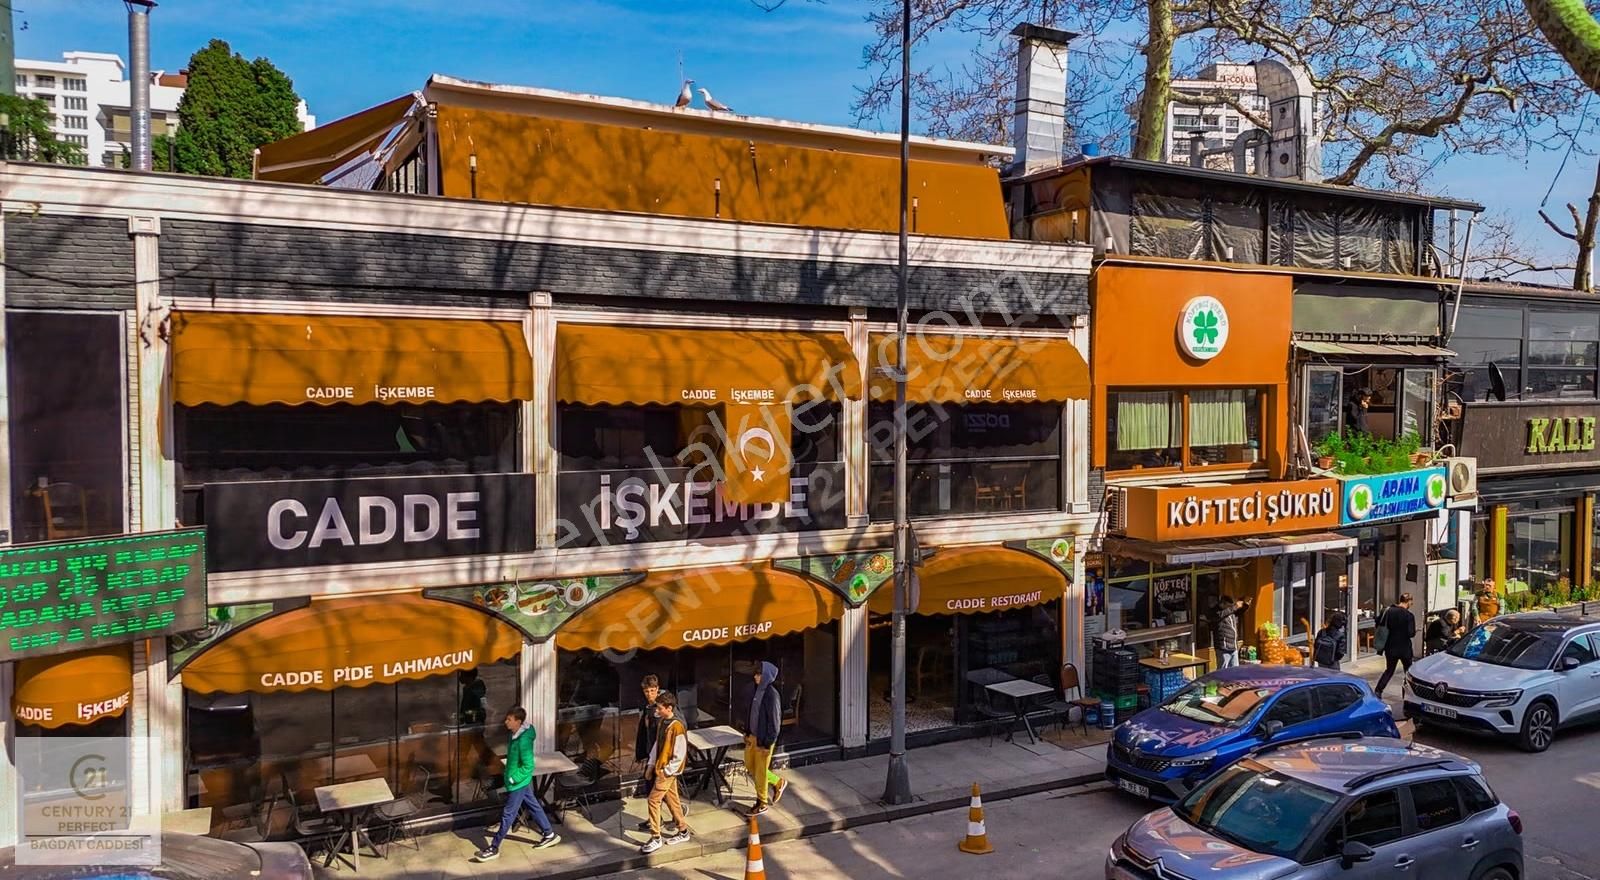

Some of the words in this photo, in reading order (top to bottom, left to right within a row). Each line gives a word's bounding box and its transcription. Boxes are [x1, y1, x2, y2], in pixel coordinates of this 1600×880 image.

[306, 387, 354, 398] CADDE
[375, 385, 435, 400] İŞKEMBE
[682, 389, 717, 399] CADDE
[731, 388, 775, 402] İŞKEMBE
[965, 389, 992, 398] CADDE
[1002, 388, 1037, 400] İŞKEMBE
[1527, 416, 1596, 453] KALE
[1169, 491, 1262, 526] KÖFTECİ
[1267, 487, 1334, 523] ŞÜKRÜ
[267, 491, 480, 550] CADDE
[946, 597, 986, 610] CADDE
[991, 590, 1042, 607] RESTORANT
[682, 627, 729, 642] CADDE
[734, 621, 772, 637] KEBAP
[261, 669, 324, 687] CADDE
[333, 665, 374, 682] PİDE
[383, 649, 474, 677] LAHMACUN
